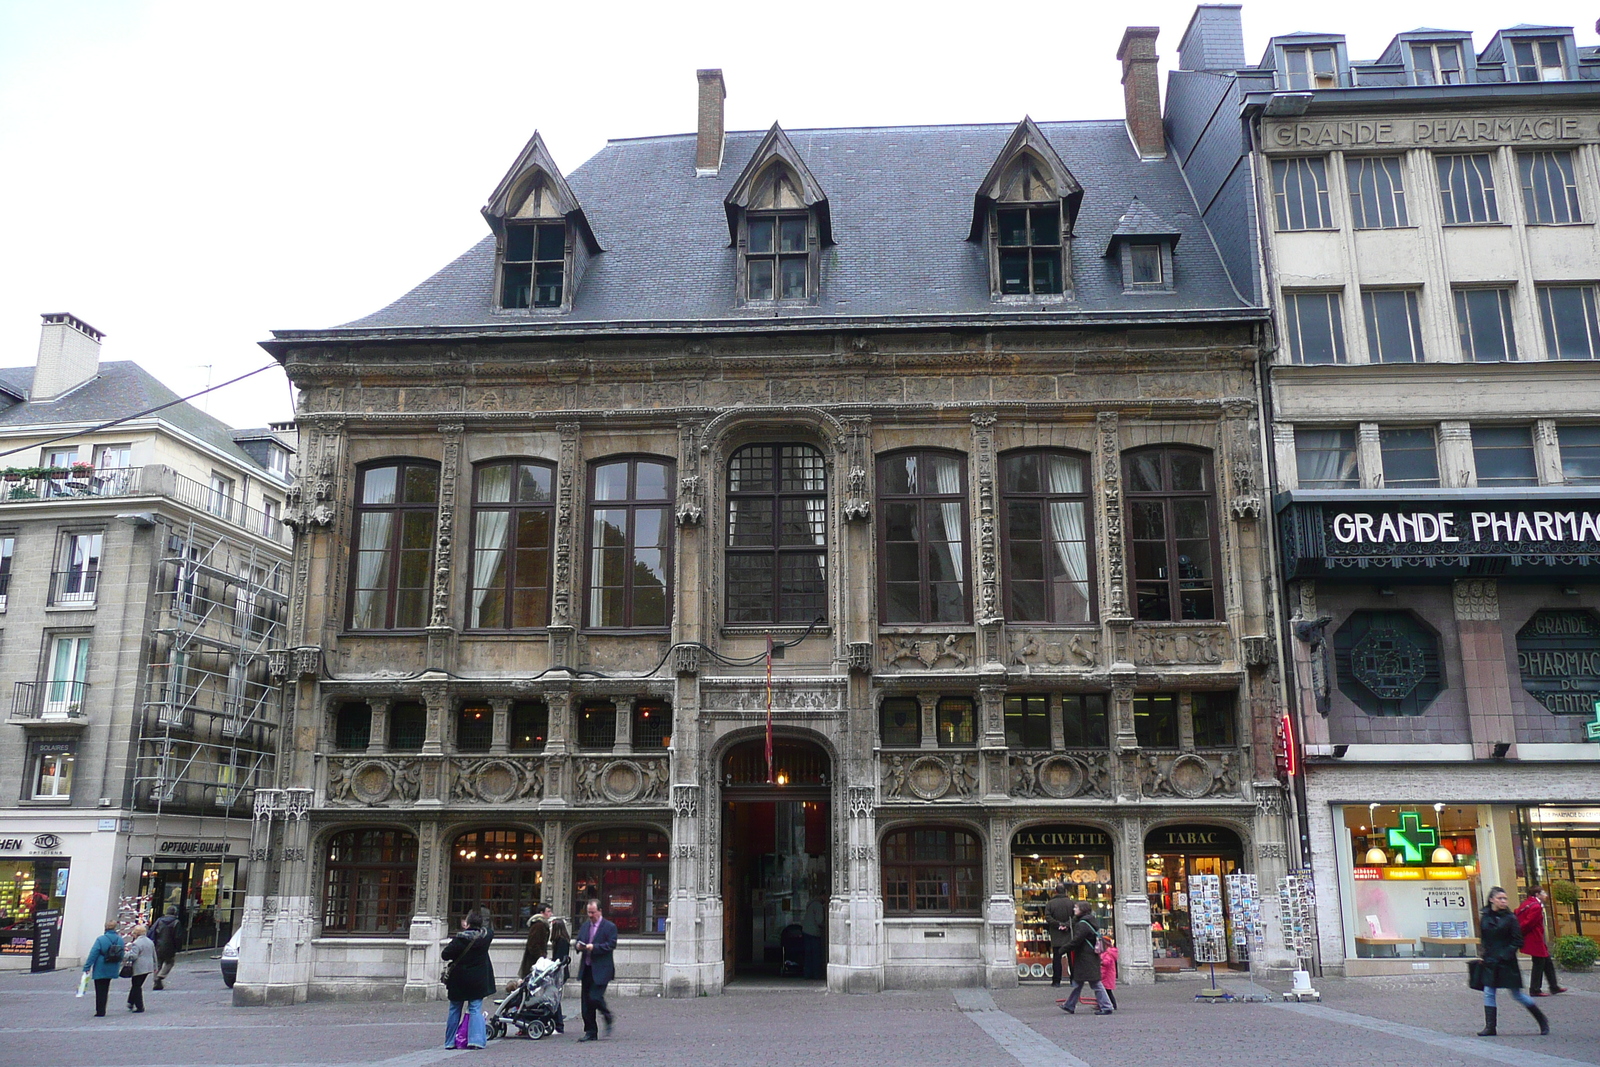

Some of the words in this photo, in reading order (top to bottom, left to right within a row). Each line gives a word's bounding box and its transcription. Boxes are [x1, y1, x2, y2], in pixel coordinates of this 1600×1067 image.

[1273, 121, 1395, 146] GRANDE
[1413, 117, 1581, 144] PHARMACIE
[1333, 512, 1460, 543] GRANDE
[1535, 616, 1590, 634] GRANDE
[1561, 679, 1580, 690] DU
[1016, 833, 1036, 845] LA
[1041, 833, 1107, 845] CIVETTE
[1165, 832, 1217, 845] TABAC
[160, 841, 199, 853] OPTIQUE
